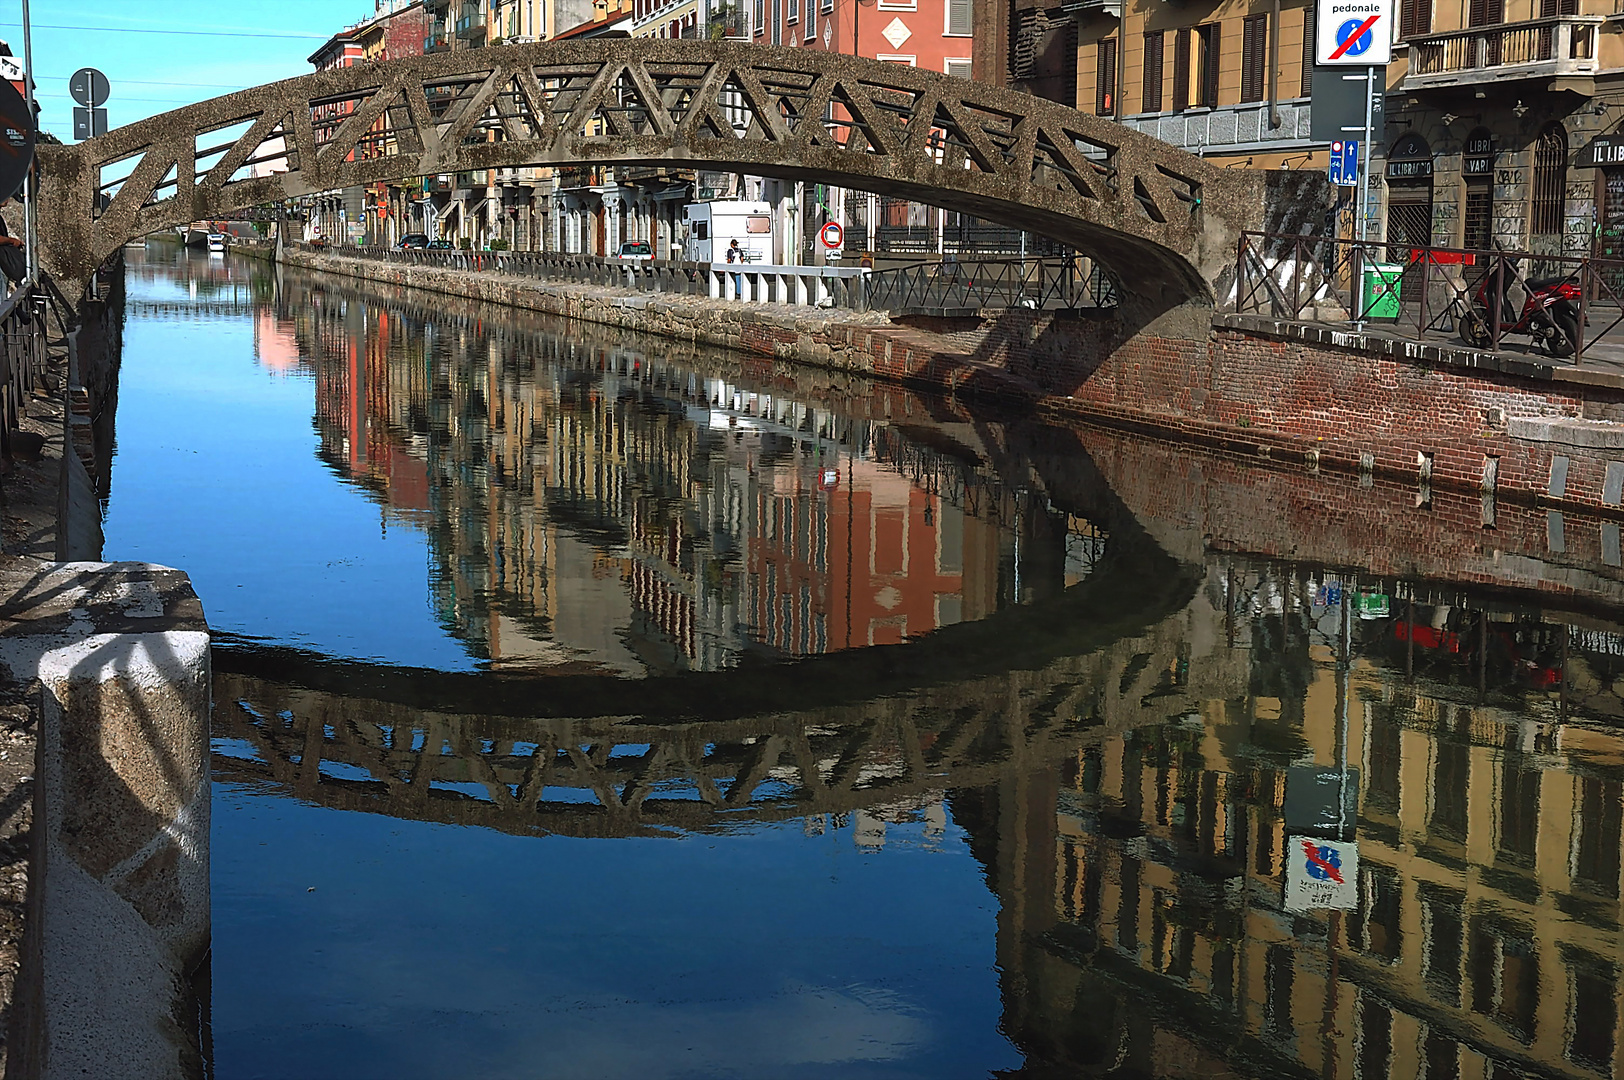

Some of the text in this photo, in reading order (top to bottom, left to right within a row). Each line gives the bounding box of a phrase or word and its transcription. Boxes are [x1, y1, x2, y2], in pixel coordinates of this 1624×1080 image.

[1332, 3, 1380, 14] pedonale
[1470, 140, 1491, 152] LIBRI
[1593, 146, 1604, 163] IL
[1470, 160, 1488, 172] VARI
